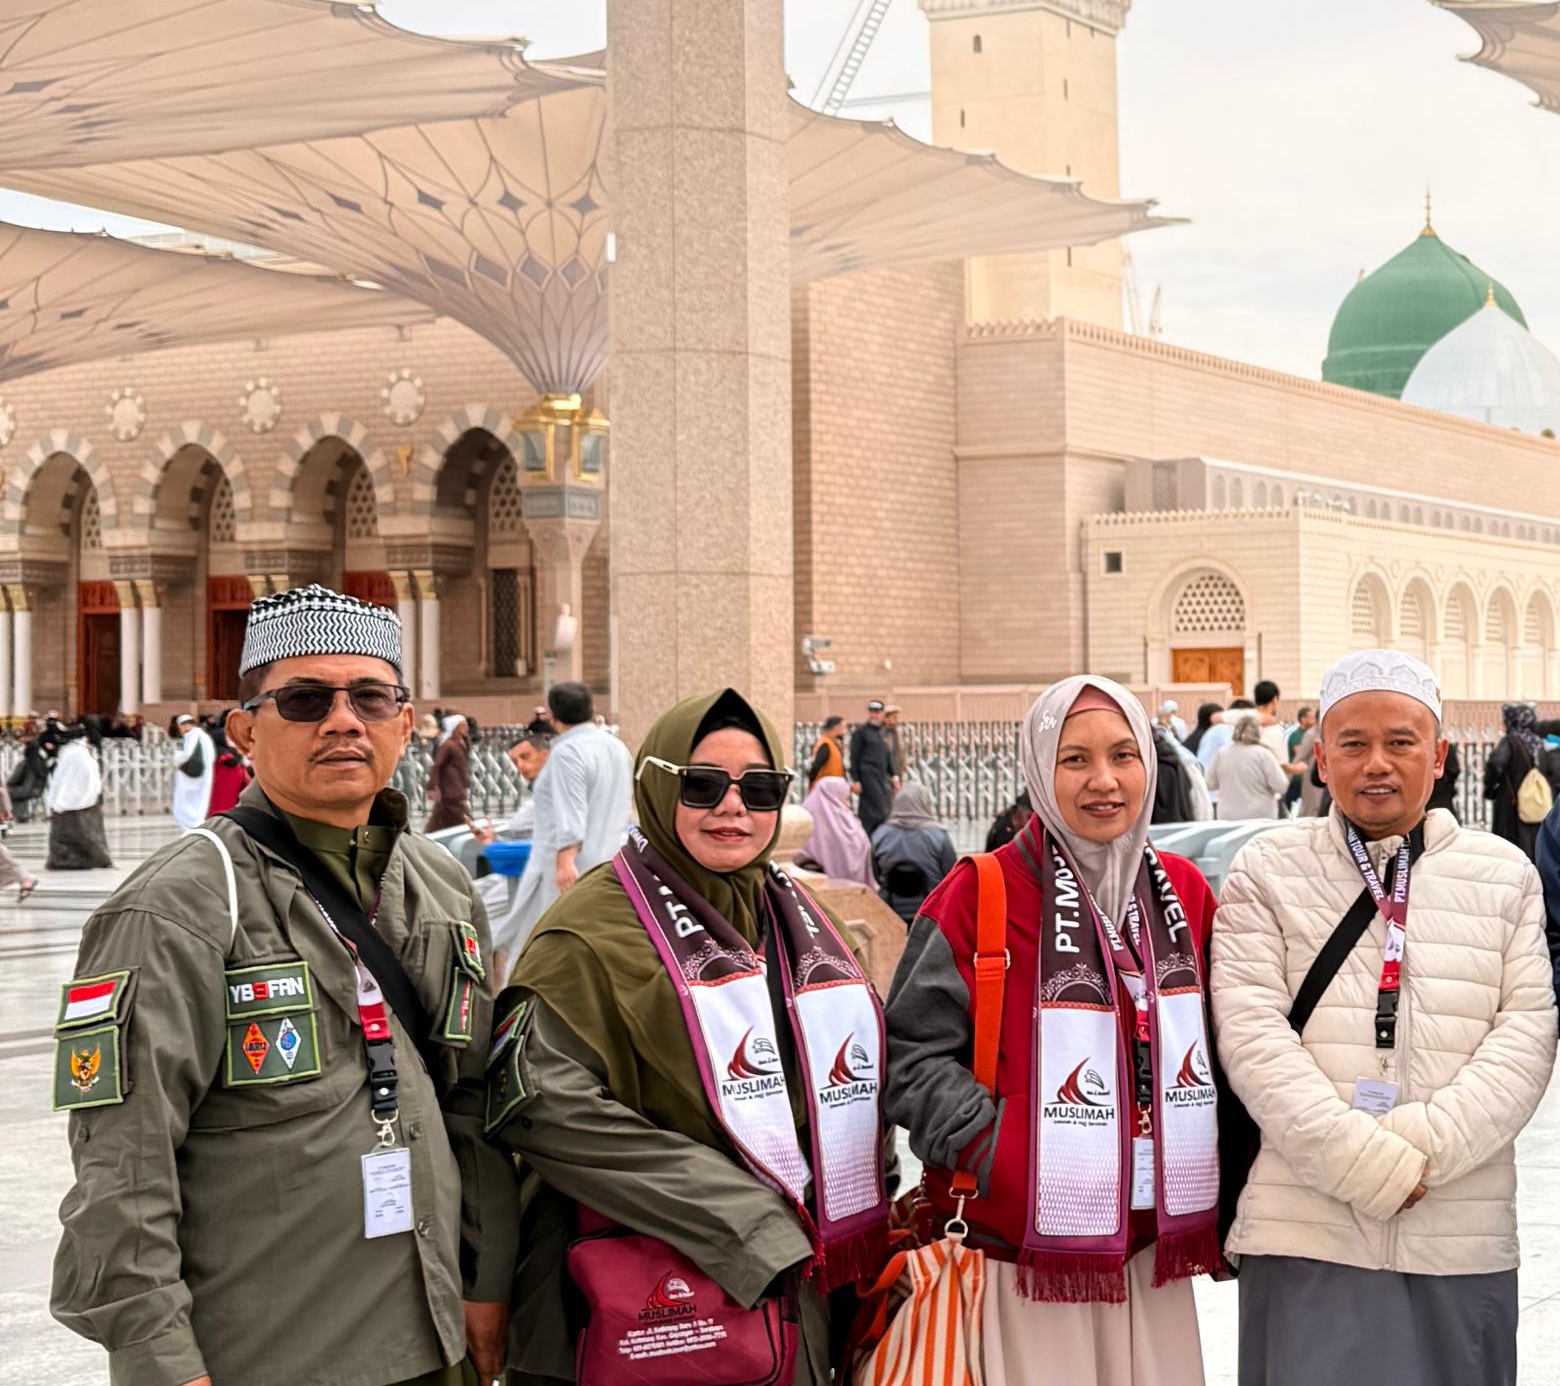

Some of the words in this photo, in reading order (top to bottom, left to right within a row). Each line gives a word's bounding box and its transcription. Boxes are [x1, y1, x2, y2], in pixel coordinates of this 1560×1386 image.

[1350, 840, 1369, 864] TOUR
[1363, 868, 1385, 901] TRAVEL
[1043, 1106, 1115, 1120] MUSLIMAH
[638, 1304, 697, 1322] MUSLIMAH
